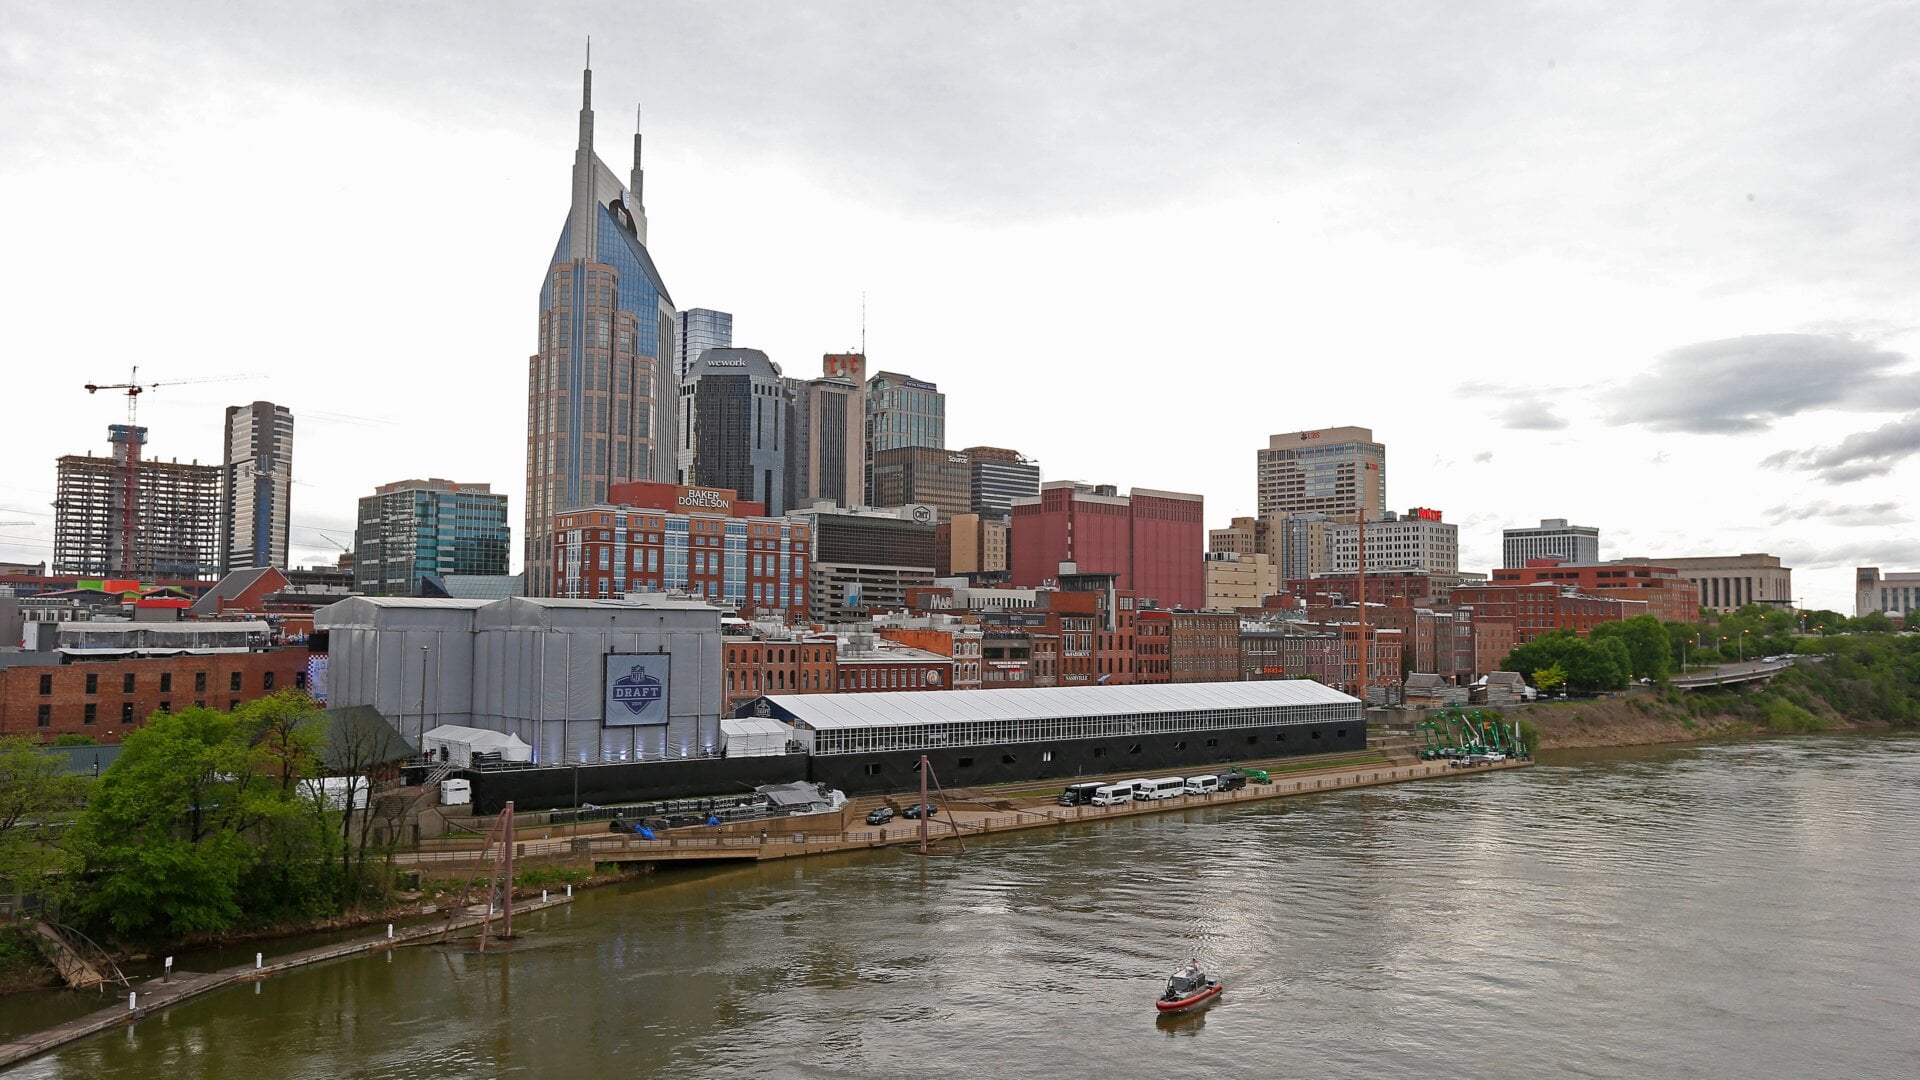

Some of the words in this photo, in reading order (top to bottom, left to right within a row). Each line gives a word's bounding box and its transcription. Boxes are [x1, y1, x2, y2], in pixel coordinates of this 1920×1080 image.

[707, 358, 746, 367] wework
[1308, 432, 1320, 440] UBS
[688, 489, 719, 500] BAKER
[678, 496, 729, 508] DONELSON
[615, 687, 659, 698] DRAFT
